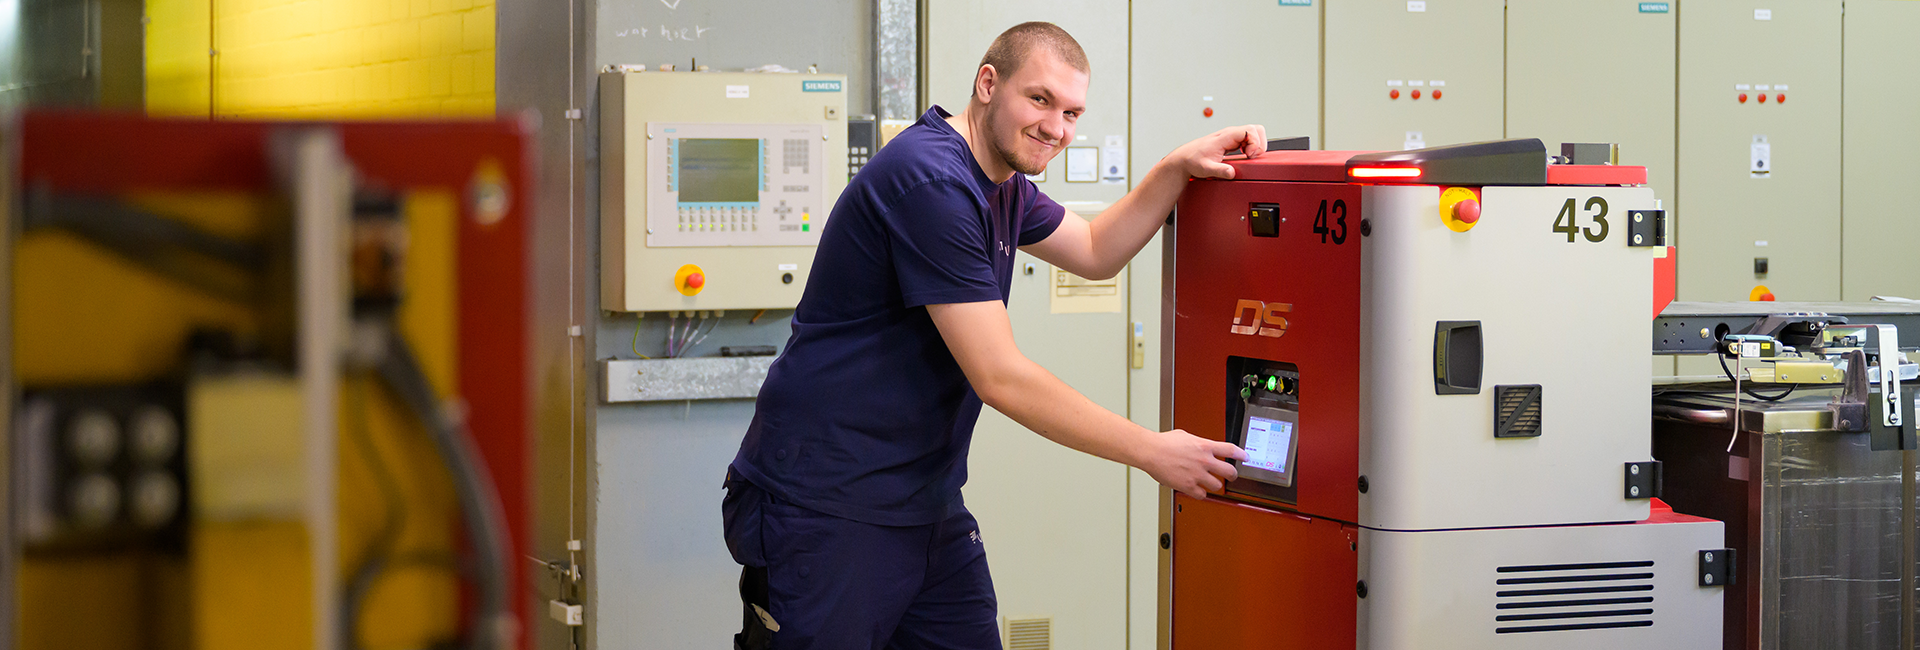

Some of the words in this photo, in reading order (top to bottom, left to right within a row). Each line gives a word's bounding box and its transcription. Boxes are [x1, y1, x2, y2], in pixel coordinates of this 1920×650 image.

[805, 83, 840, 91] SIEMENS
[1313, 199, 1347, 245] 43
[1552, 196, 1610, 243] 43
[1230, 299, 1293, 338] DS
